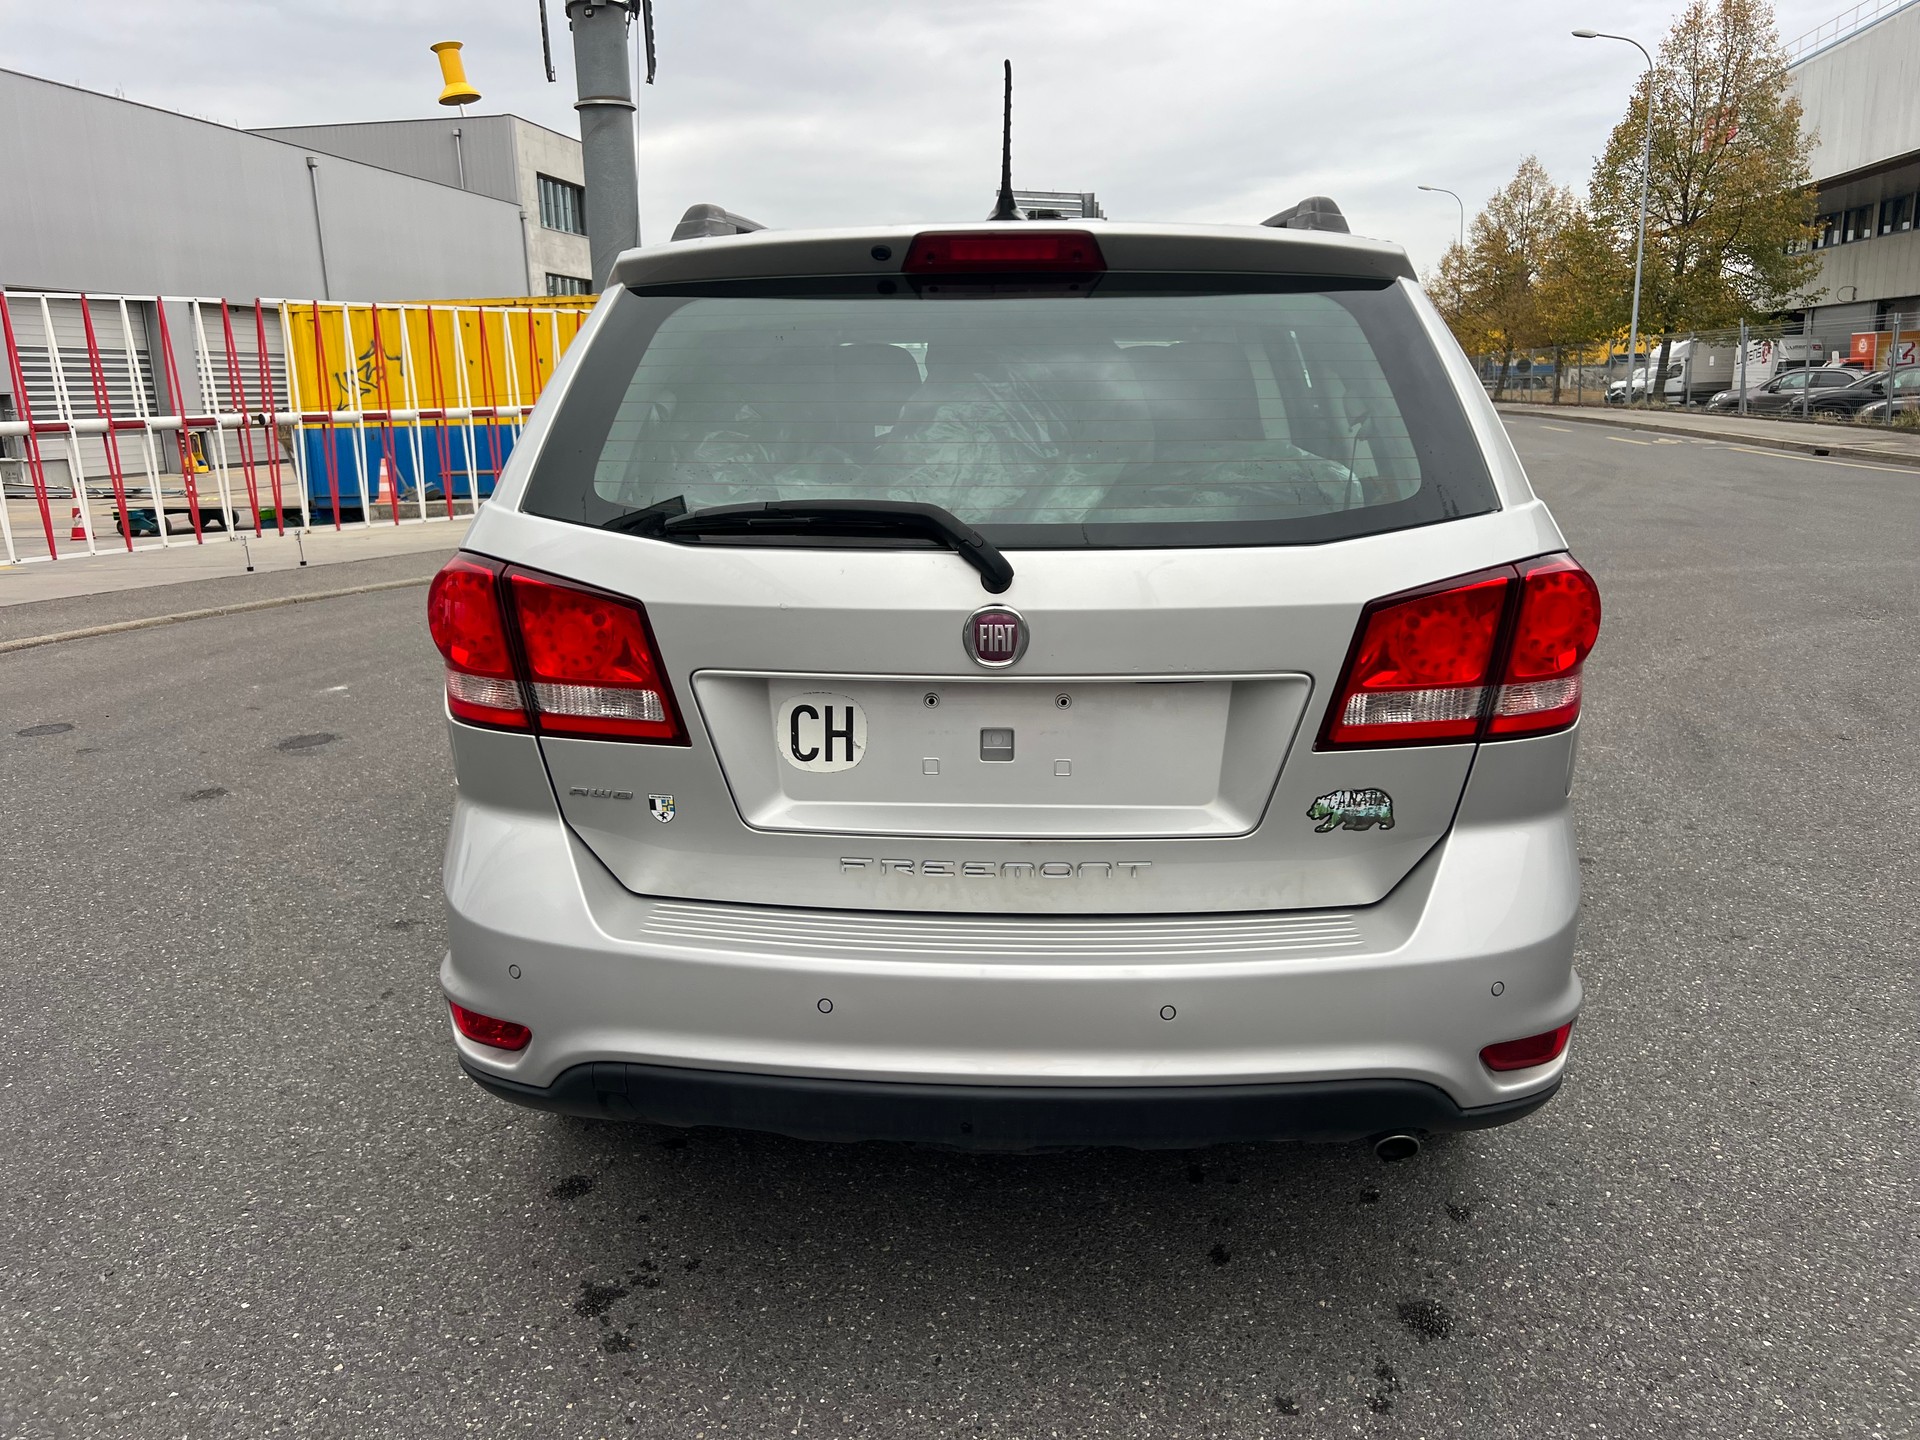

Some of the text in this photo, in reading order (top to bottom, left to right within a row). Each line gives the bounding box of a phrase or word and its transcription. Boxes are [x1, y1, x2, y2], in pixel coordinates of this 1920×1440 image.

[980, 624, 1015, 652] FIAT
[791, 704, 854, 762] CH
[569, 786, 633, 800] AWD
[1328, 790, 1390, 810] CANADA
[840, 856, 1152, 878] FREEMONT
